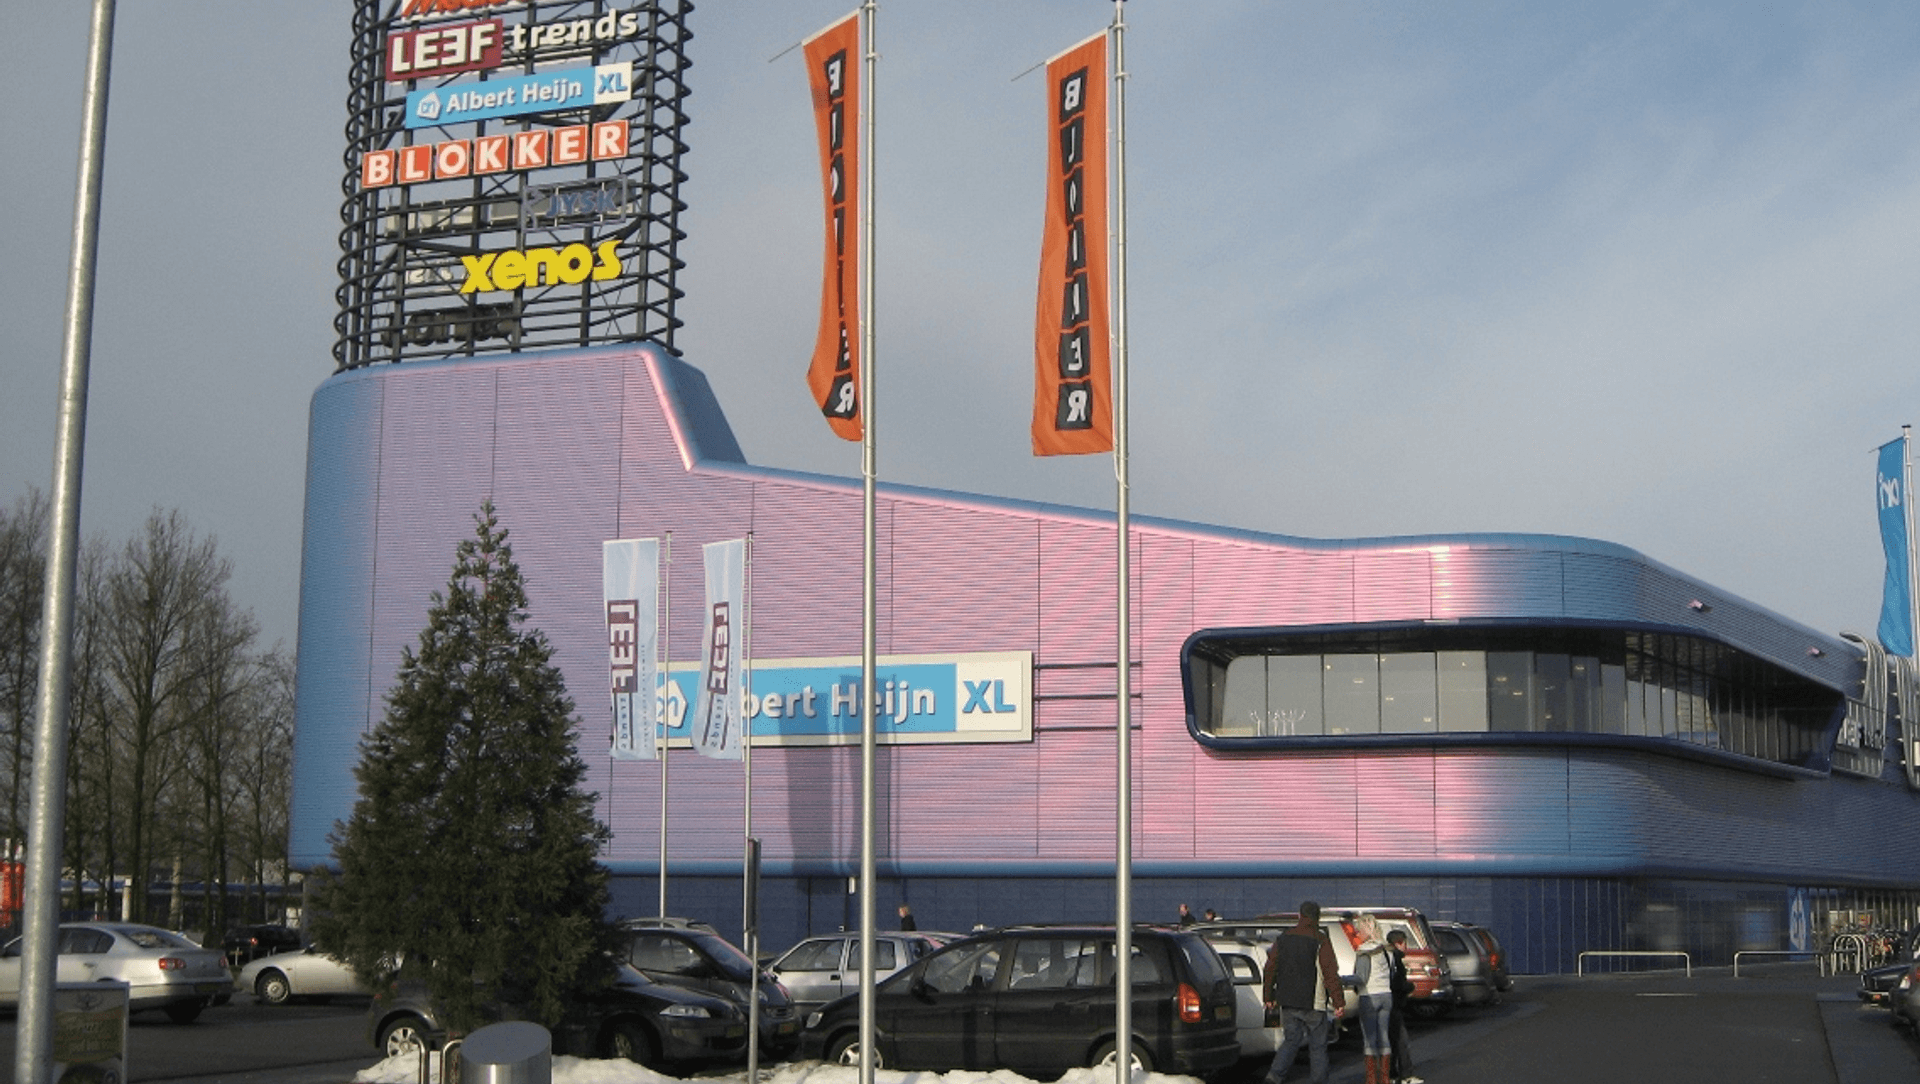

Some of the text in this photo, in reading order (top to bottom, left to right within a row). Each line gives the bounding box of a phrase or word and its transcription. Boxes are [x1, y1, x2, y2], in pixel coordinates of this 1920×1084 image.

[391, 23, 496, 73] LEEF
[511, 9, 640, 51] trends
[446, 86, 516, 114] Albert
[522, 78, 583, 104] Heijn
[597, 72, 629, 96] XL
[366, 122, 625, 185] BLOKKER
[545, 187, 618, 218] JYSK
[459, 239, 624, 294] xenos
[741, 685, 817, 719] bert
[962, 679, 1018, 715] XL
